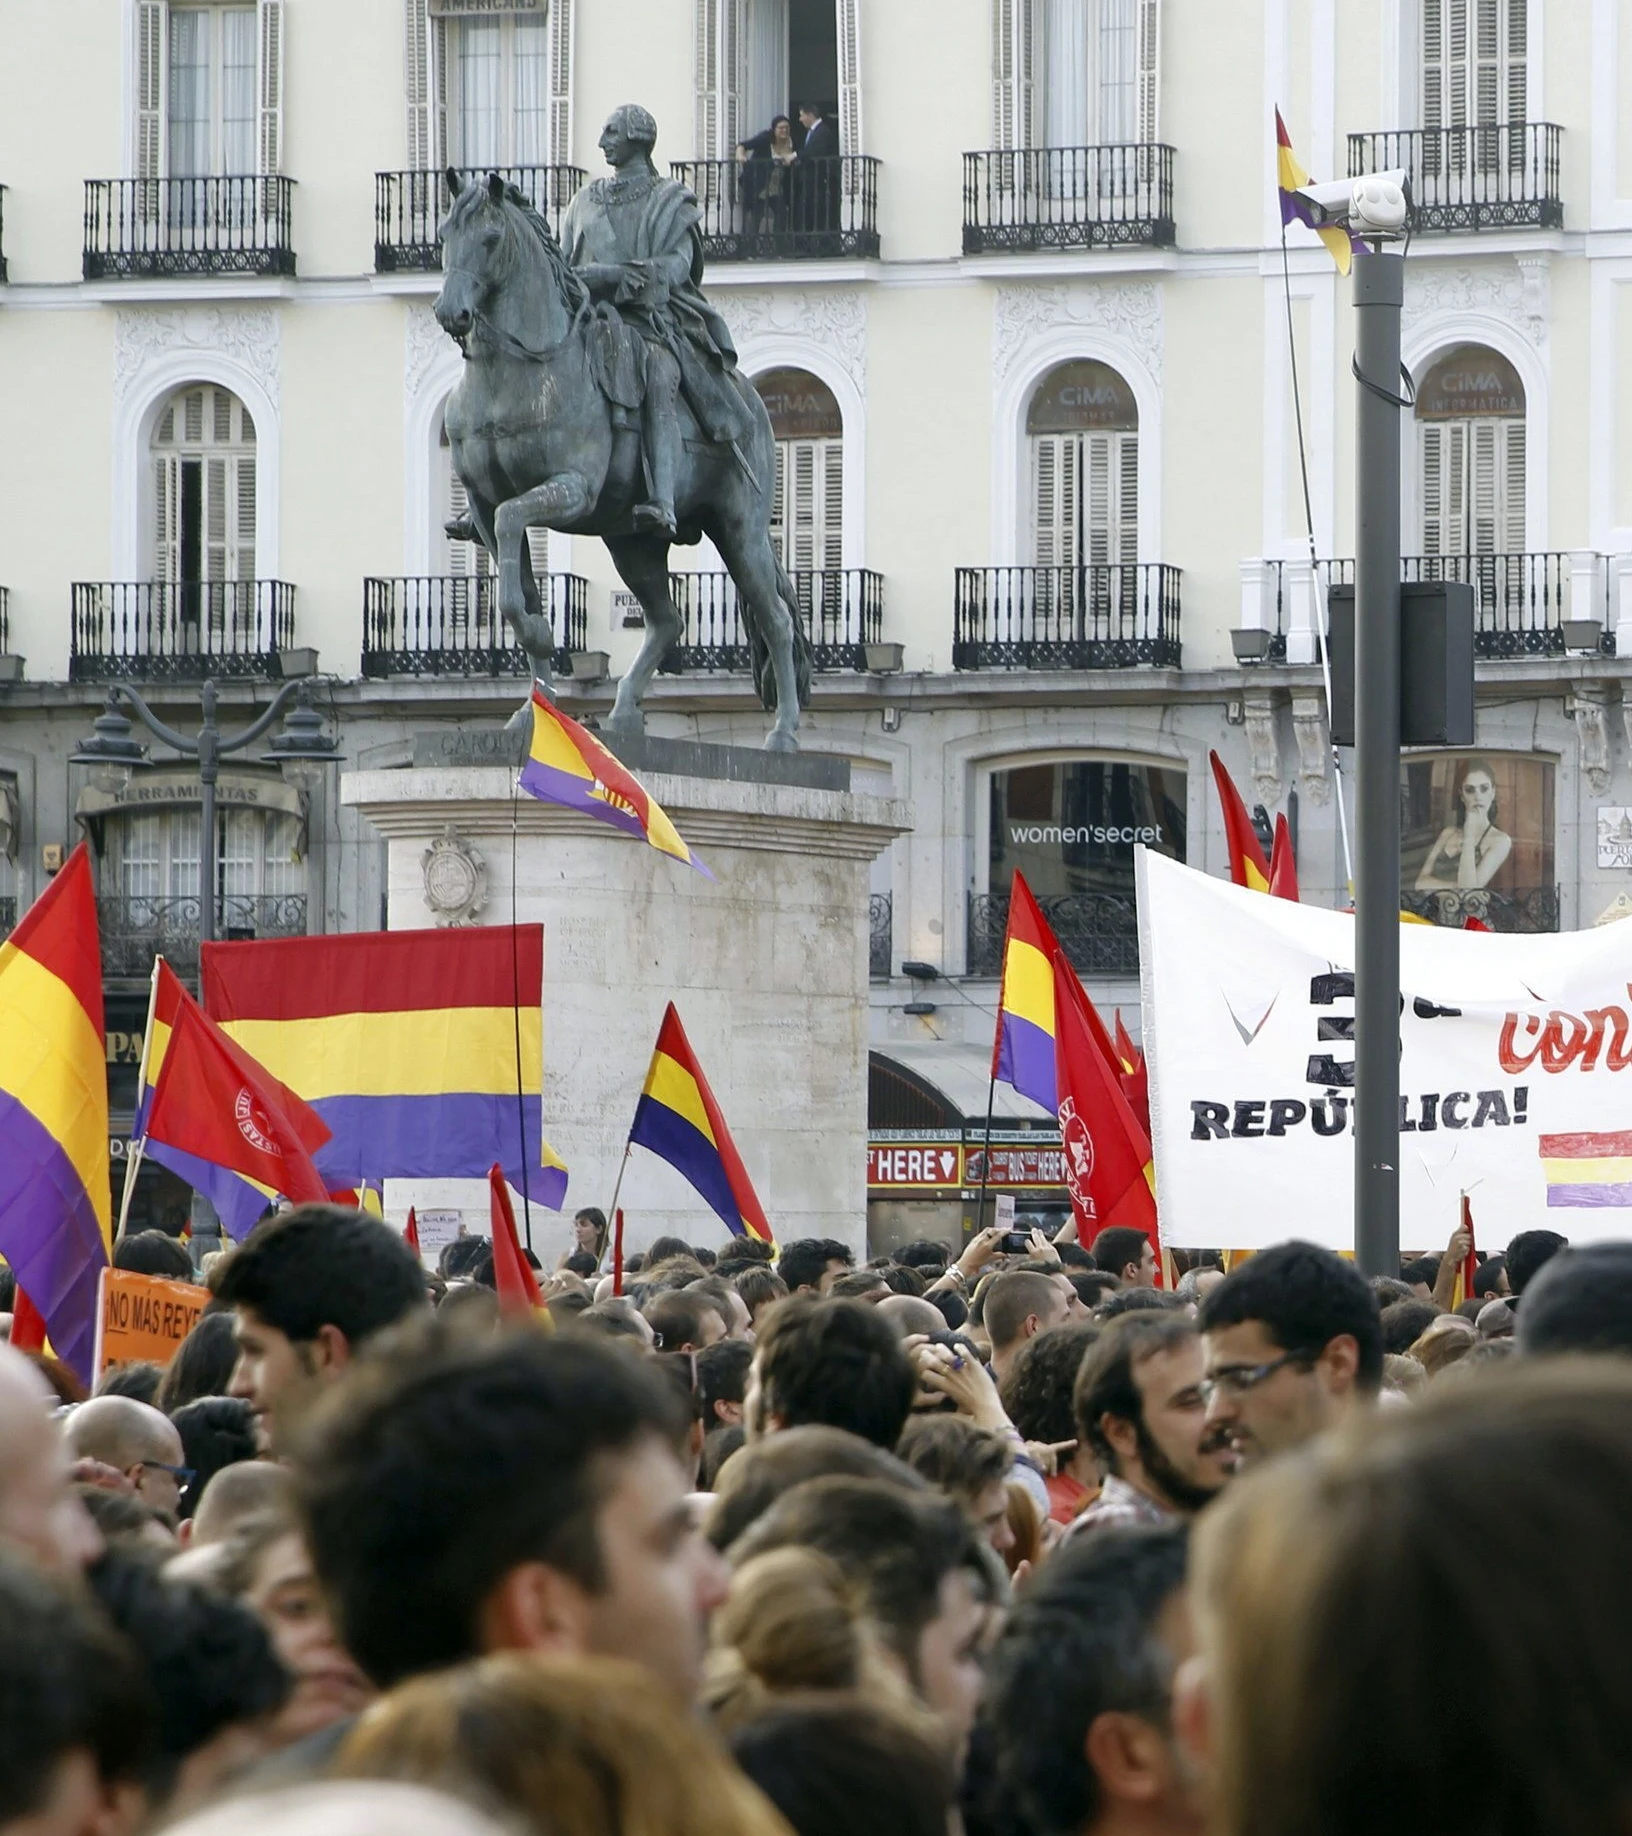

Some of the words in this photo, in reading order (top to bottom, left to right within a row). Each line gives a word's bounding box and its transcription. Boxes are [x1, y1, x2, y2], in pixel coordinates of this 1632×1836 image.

[114, 784, 259, 803] HERRAMINTAS
[1010, 823, 1164, 844] women'secret
[1190, 1086, 1529, 1142] REPÚLICA!
[878, 1149, 936, 1181] HERE
[1038, 1151, 1061, 1181] HERE
[132, 1288, 160, 1335] MÁS
